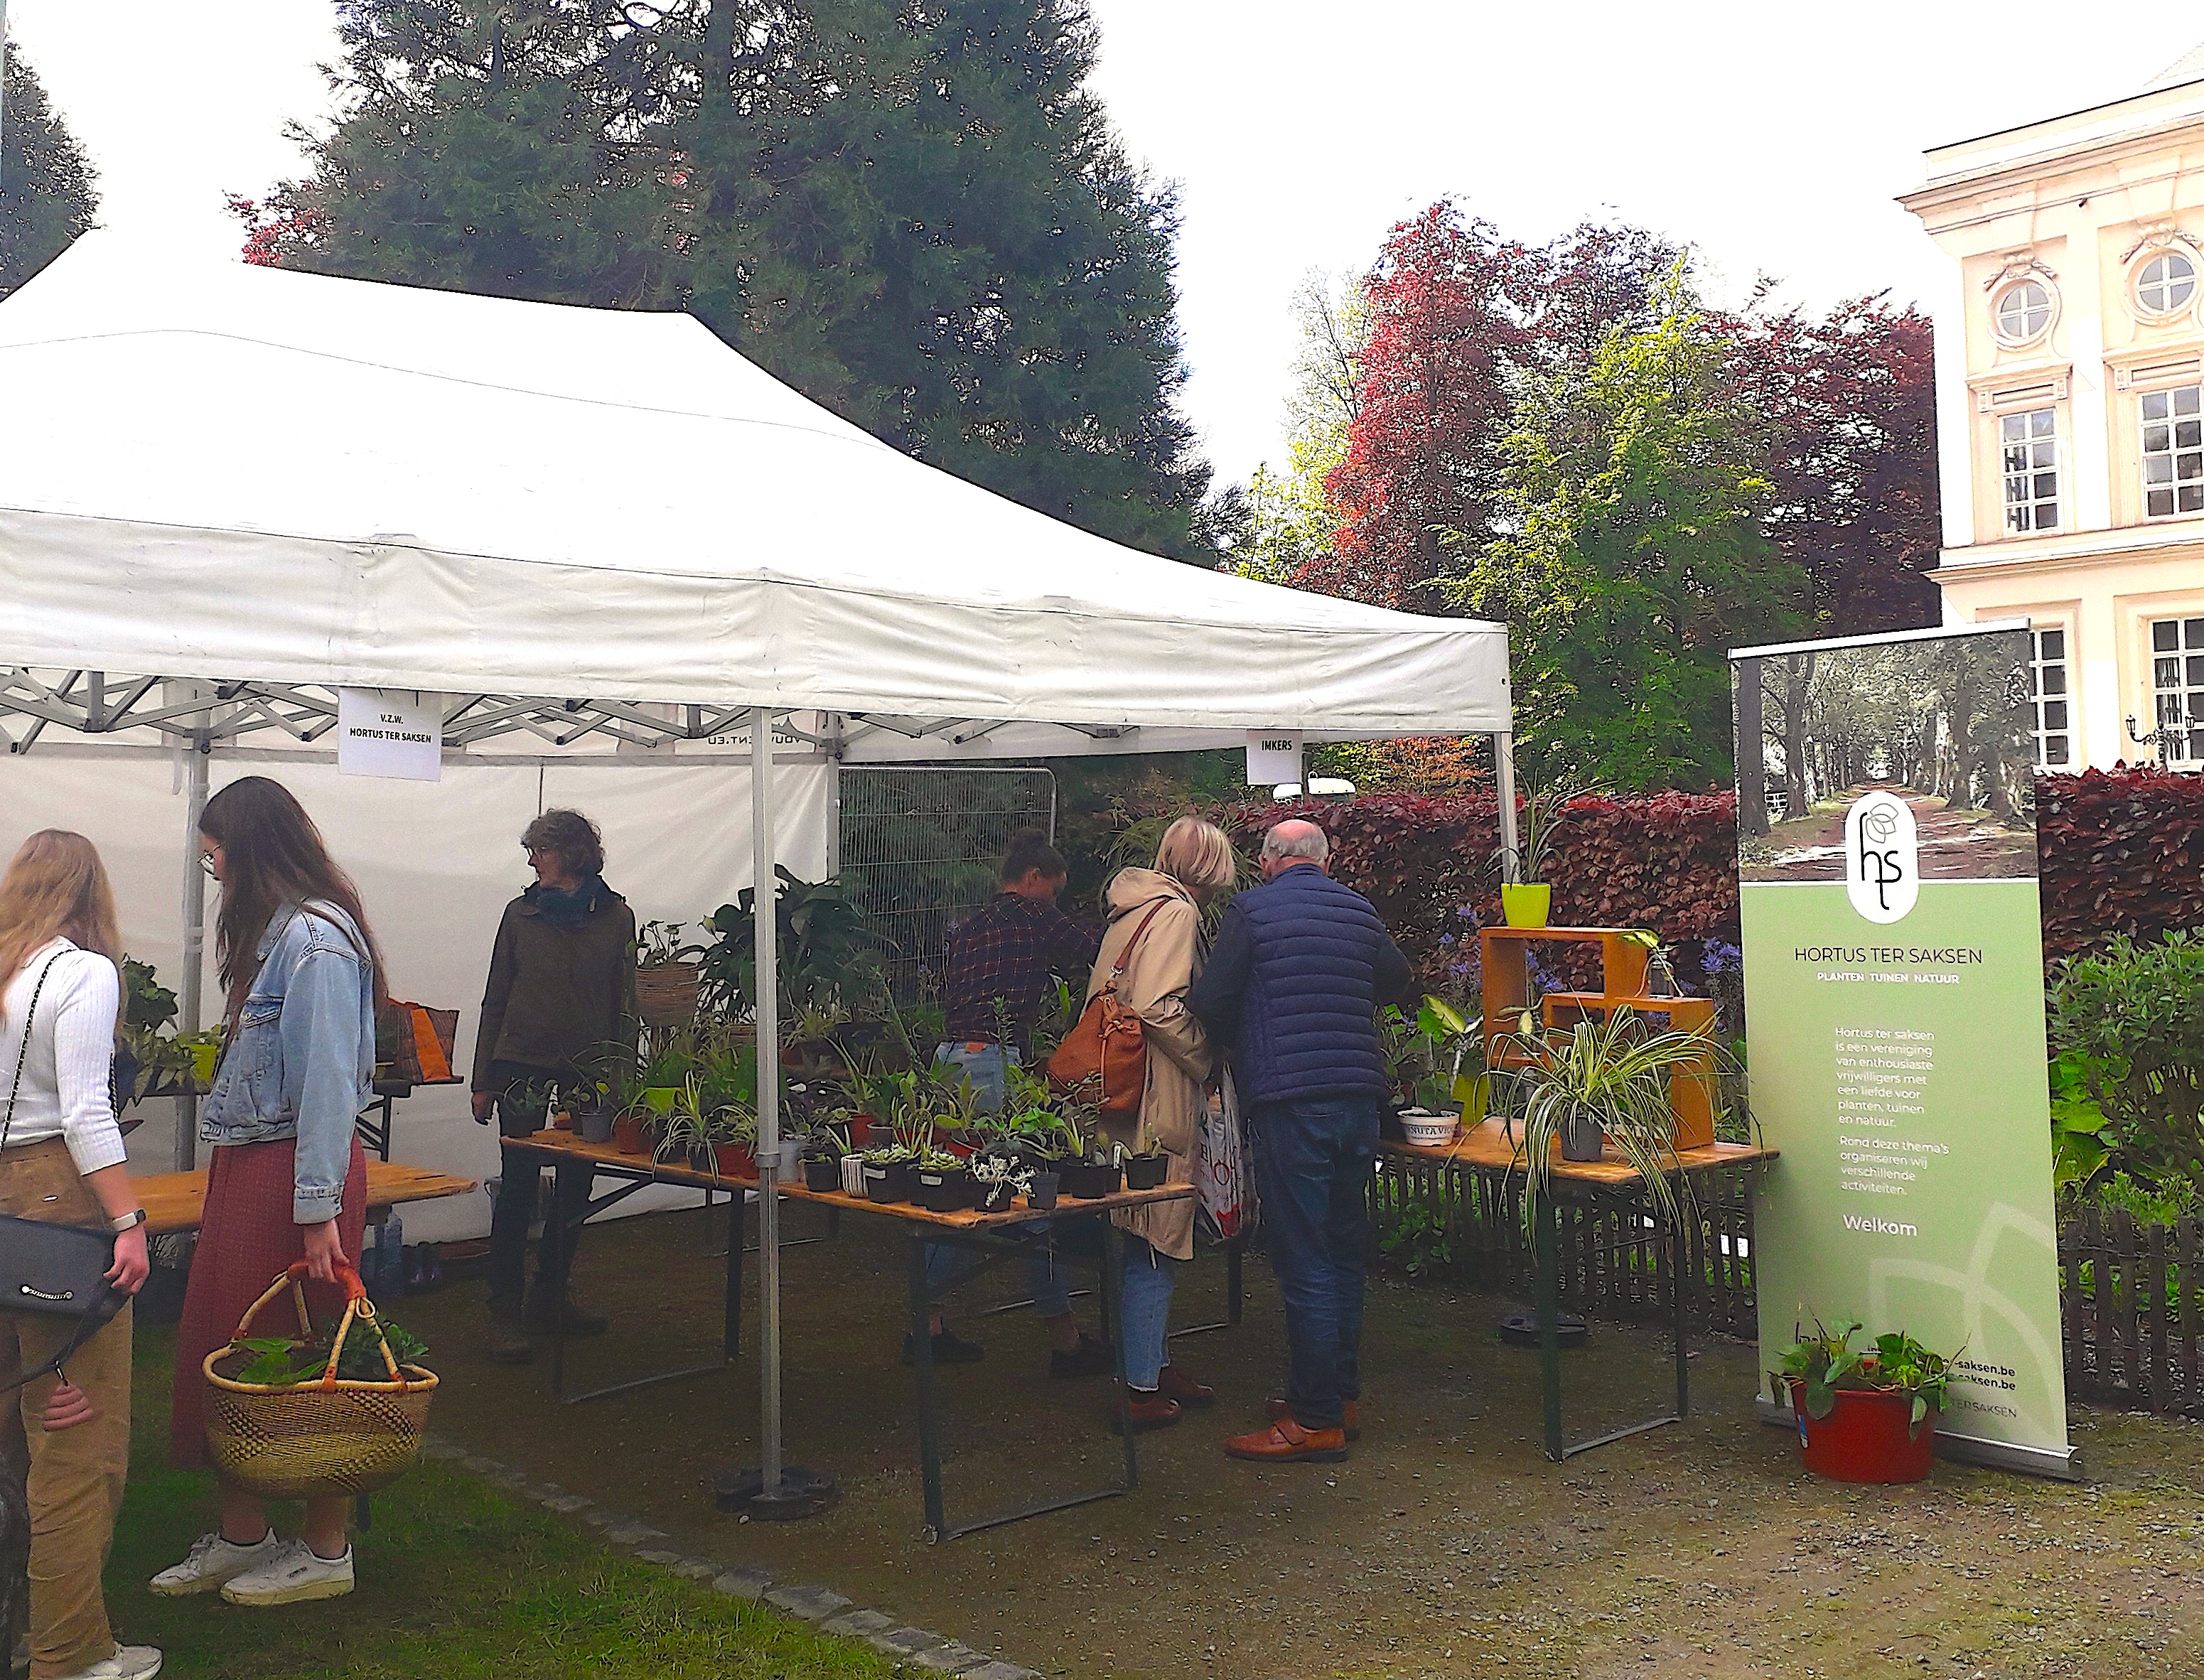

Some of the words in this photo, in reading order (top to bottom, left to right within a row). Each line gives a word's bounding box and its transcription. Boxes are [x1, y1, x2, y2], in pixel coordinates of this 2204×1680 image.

[380, 714, 404, 724] V.Z.W.
[350, 727, 384, 739] HORTUS
[385, 731, 400, 741] TER
[402, 732, 431, 743] SAKSEN
[1262, 740, 1292, 751] IMKERS
[1795, 947, 1866, 962] HORTUS
[1870, 948, 1905, 963] TER
[1909, 949, 1982, 964] SAKSEN
[1817, 971, 1865, 982] PLANTEN
[1869, 972, 1909, 983] TUINEN
[1913, 973, 1960, 984] NATUUR
[1834, 1027, 1874, 1038] Hortus
[1876, 1028, 1892, 1039] ter
[1894, 1029, 1935, 1040] saksen
[1836, 1041, 1845, 1052] is
[1846, 1043, 1869, 1052] een
[1871, 1043, 1933, 1058] vereniging
[1837, 1057, 1856, 1066] van
[1859, 1057, 1935, 1070] enthousiaste
[1837, 1070, 1901, 1084] vrijwilligers
[1903, 1075, 1928, 1085] met
[1837, 1086, 1859, 1095] een
[1861, 1086, 1893, 1097] liefde
[1894, 1089, 1921, 1099] voor
[1838, 1100, 1884, 1112] planten,
[1886, 1102, 1925, 1114] tuinen
[1838, 1115, 1853, 1124] en
[1855, 1116, 1897, 1127] natuur.
[1839, 1136, 1870, 1148] Rond
[1872, 1138, 1900, 1150] deze
[1902, 1141, 1950, 1155] thema's
[1840, 1151, 1908, 1165] organiseren
[1910, 1156, 1928, 1170] wij
[1841, 1166, 1916, 1181] verschillende
[1841, 1180, 1908, 1195] activiteiten.
[1842, 1214, 1918, 1237] Welkom
